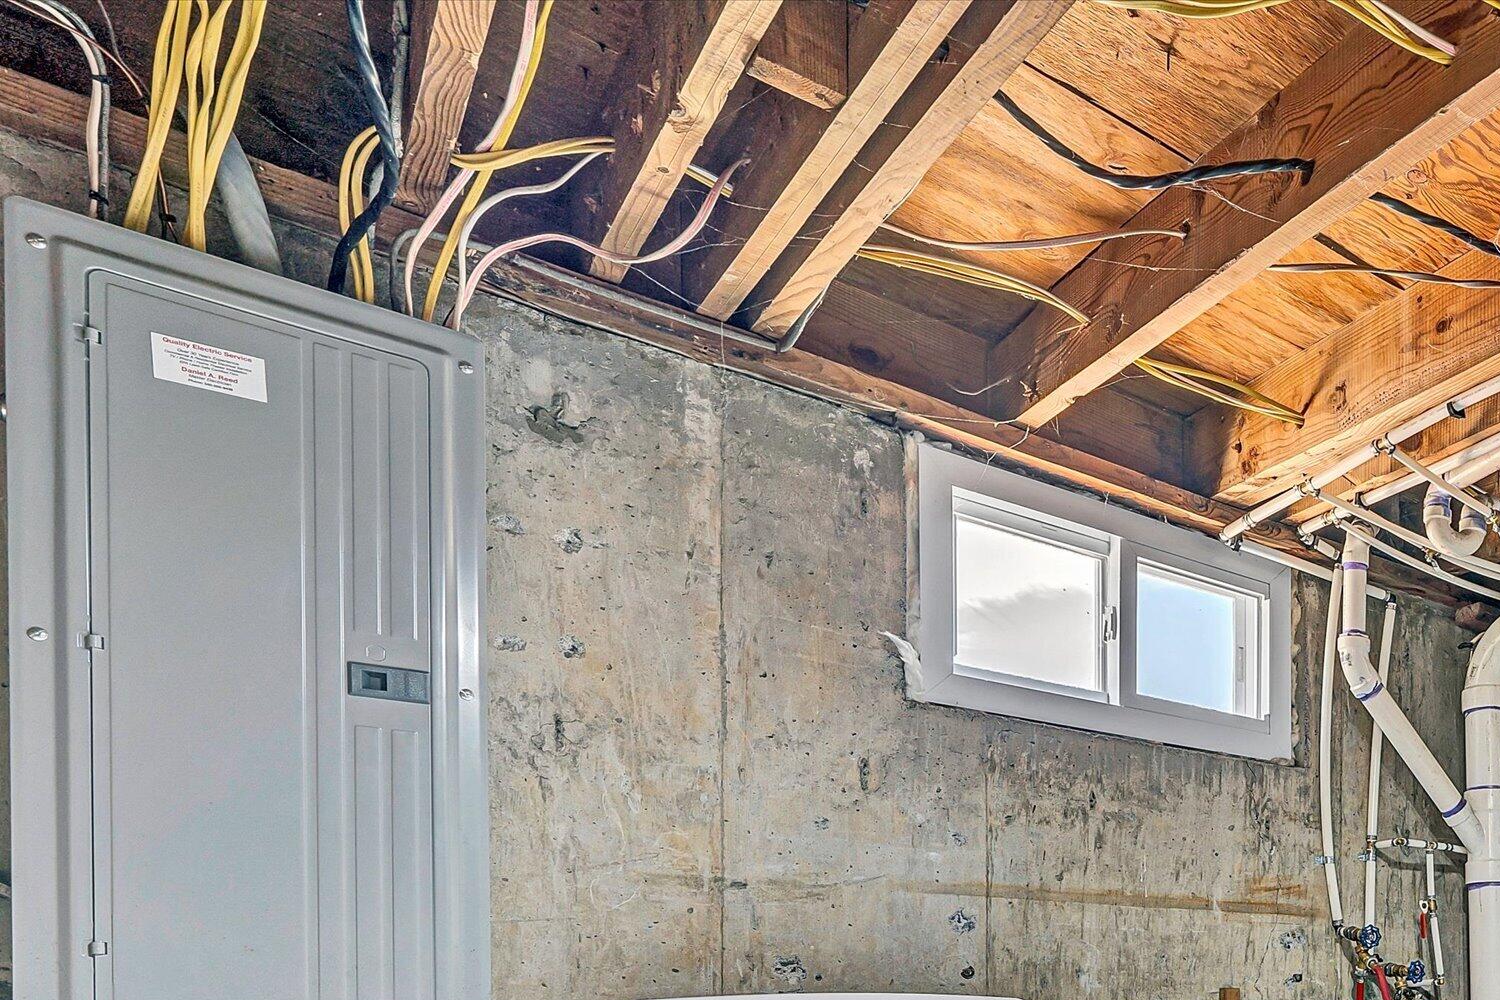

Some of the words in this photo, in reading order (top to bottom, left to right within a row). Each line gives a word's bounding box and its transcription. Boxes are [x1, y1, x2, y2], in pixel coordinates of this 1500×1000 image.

[162, 336, 190, 348] Quality
[192, 344, 222, 356] Electric
[224, 351, 252, 363] Service
[181, 366, 206, 377] Daniel
[218, 375, 238, 384] Reed
